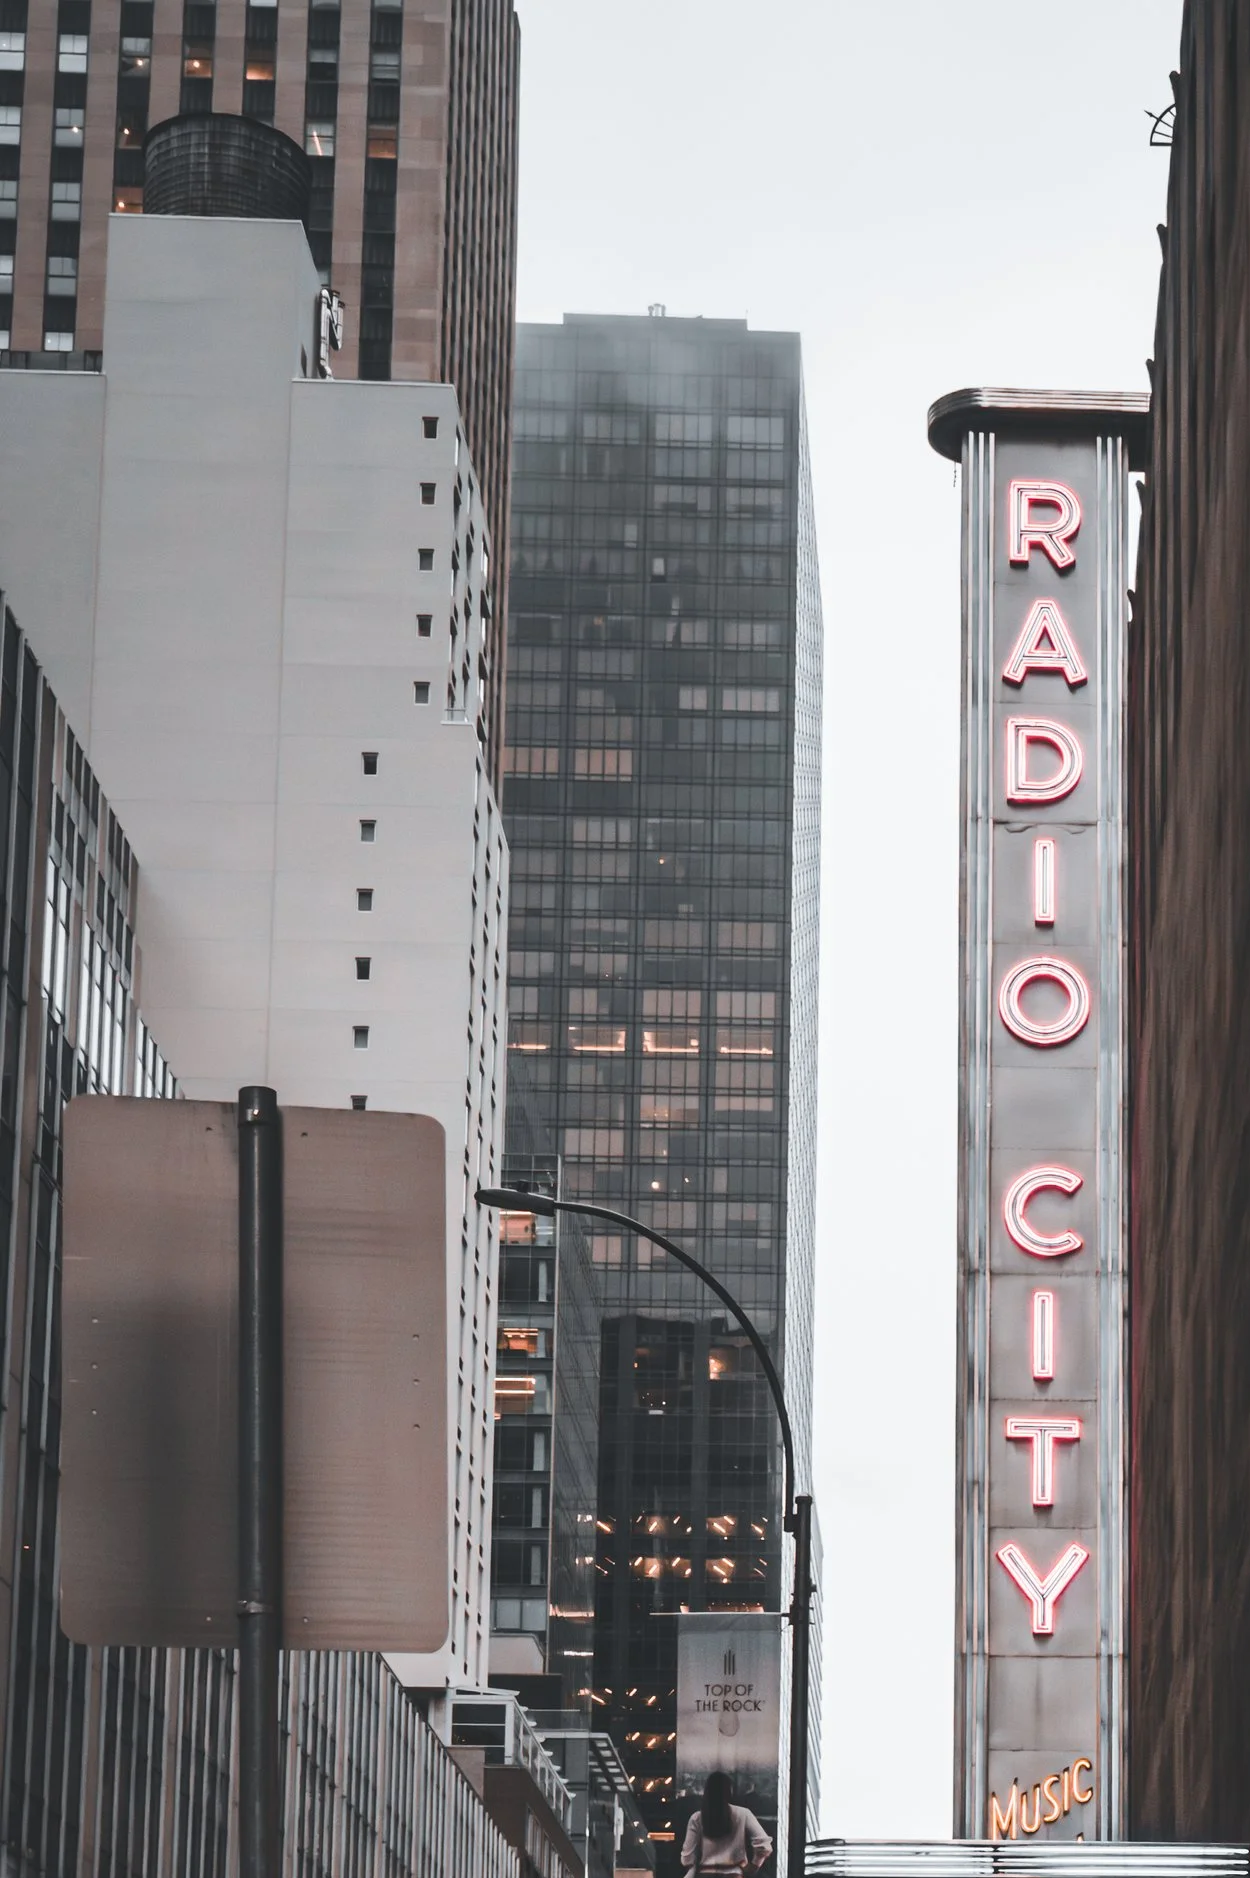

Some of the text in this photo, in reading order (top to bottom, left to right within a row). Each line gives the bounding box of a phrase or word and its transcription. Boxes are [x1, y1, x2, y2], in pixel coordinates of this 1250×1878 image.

[996, 479, 1091, 1637] RADIO CITY
[695, 1699, 719, 1713] THE
[704, 1683, 754, 1697] TOP OF
[989, 1756, 1094, 1841] MUSIC
